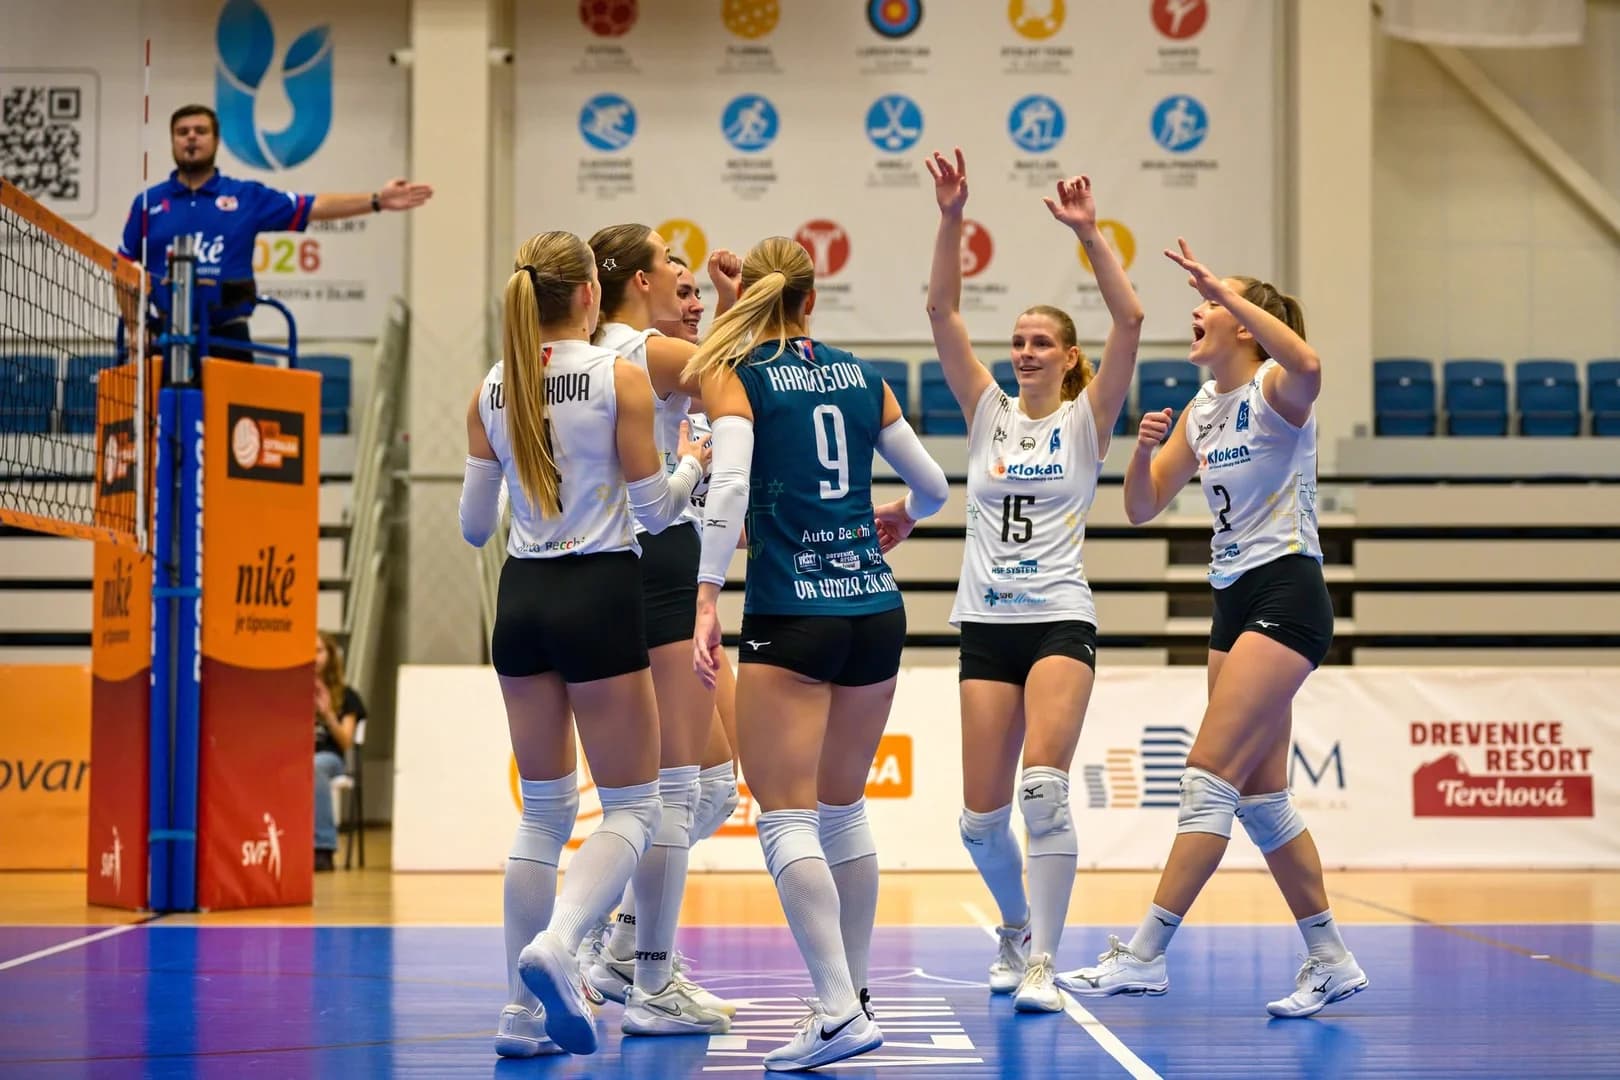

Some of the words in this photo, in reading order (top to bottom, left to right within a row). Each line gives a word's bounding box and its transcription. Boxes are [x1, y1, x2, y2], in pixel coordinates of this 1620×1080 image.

[813, 404, 849, 499] 9
[1208, 445, 1249, 464] Klokan
[1007, 463, 1063, 476] Klokan
[1001, 494, 1036, 543] 15
[1212, 484, 1233, 533] 2
[802, 528, 834, 543] Auto
[235, 545, 296, 608] niké
[794, 580, 817, 600] VA
[1410, 722, 1563, 746] DREVENICE
[1486, 748, 1593, 771] RESORT
[1437, 779, 1568, 807] Terchová
[241, 839, 269, 867] SVF
